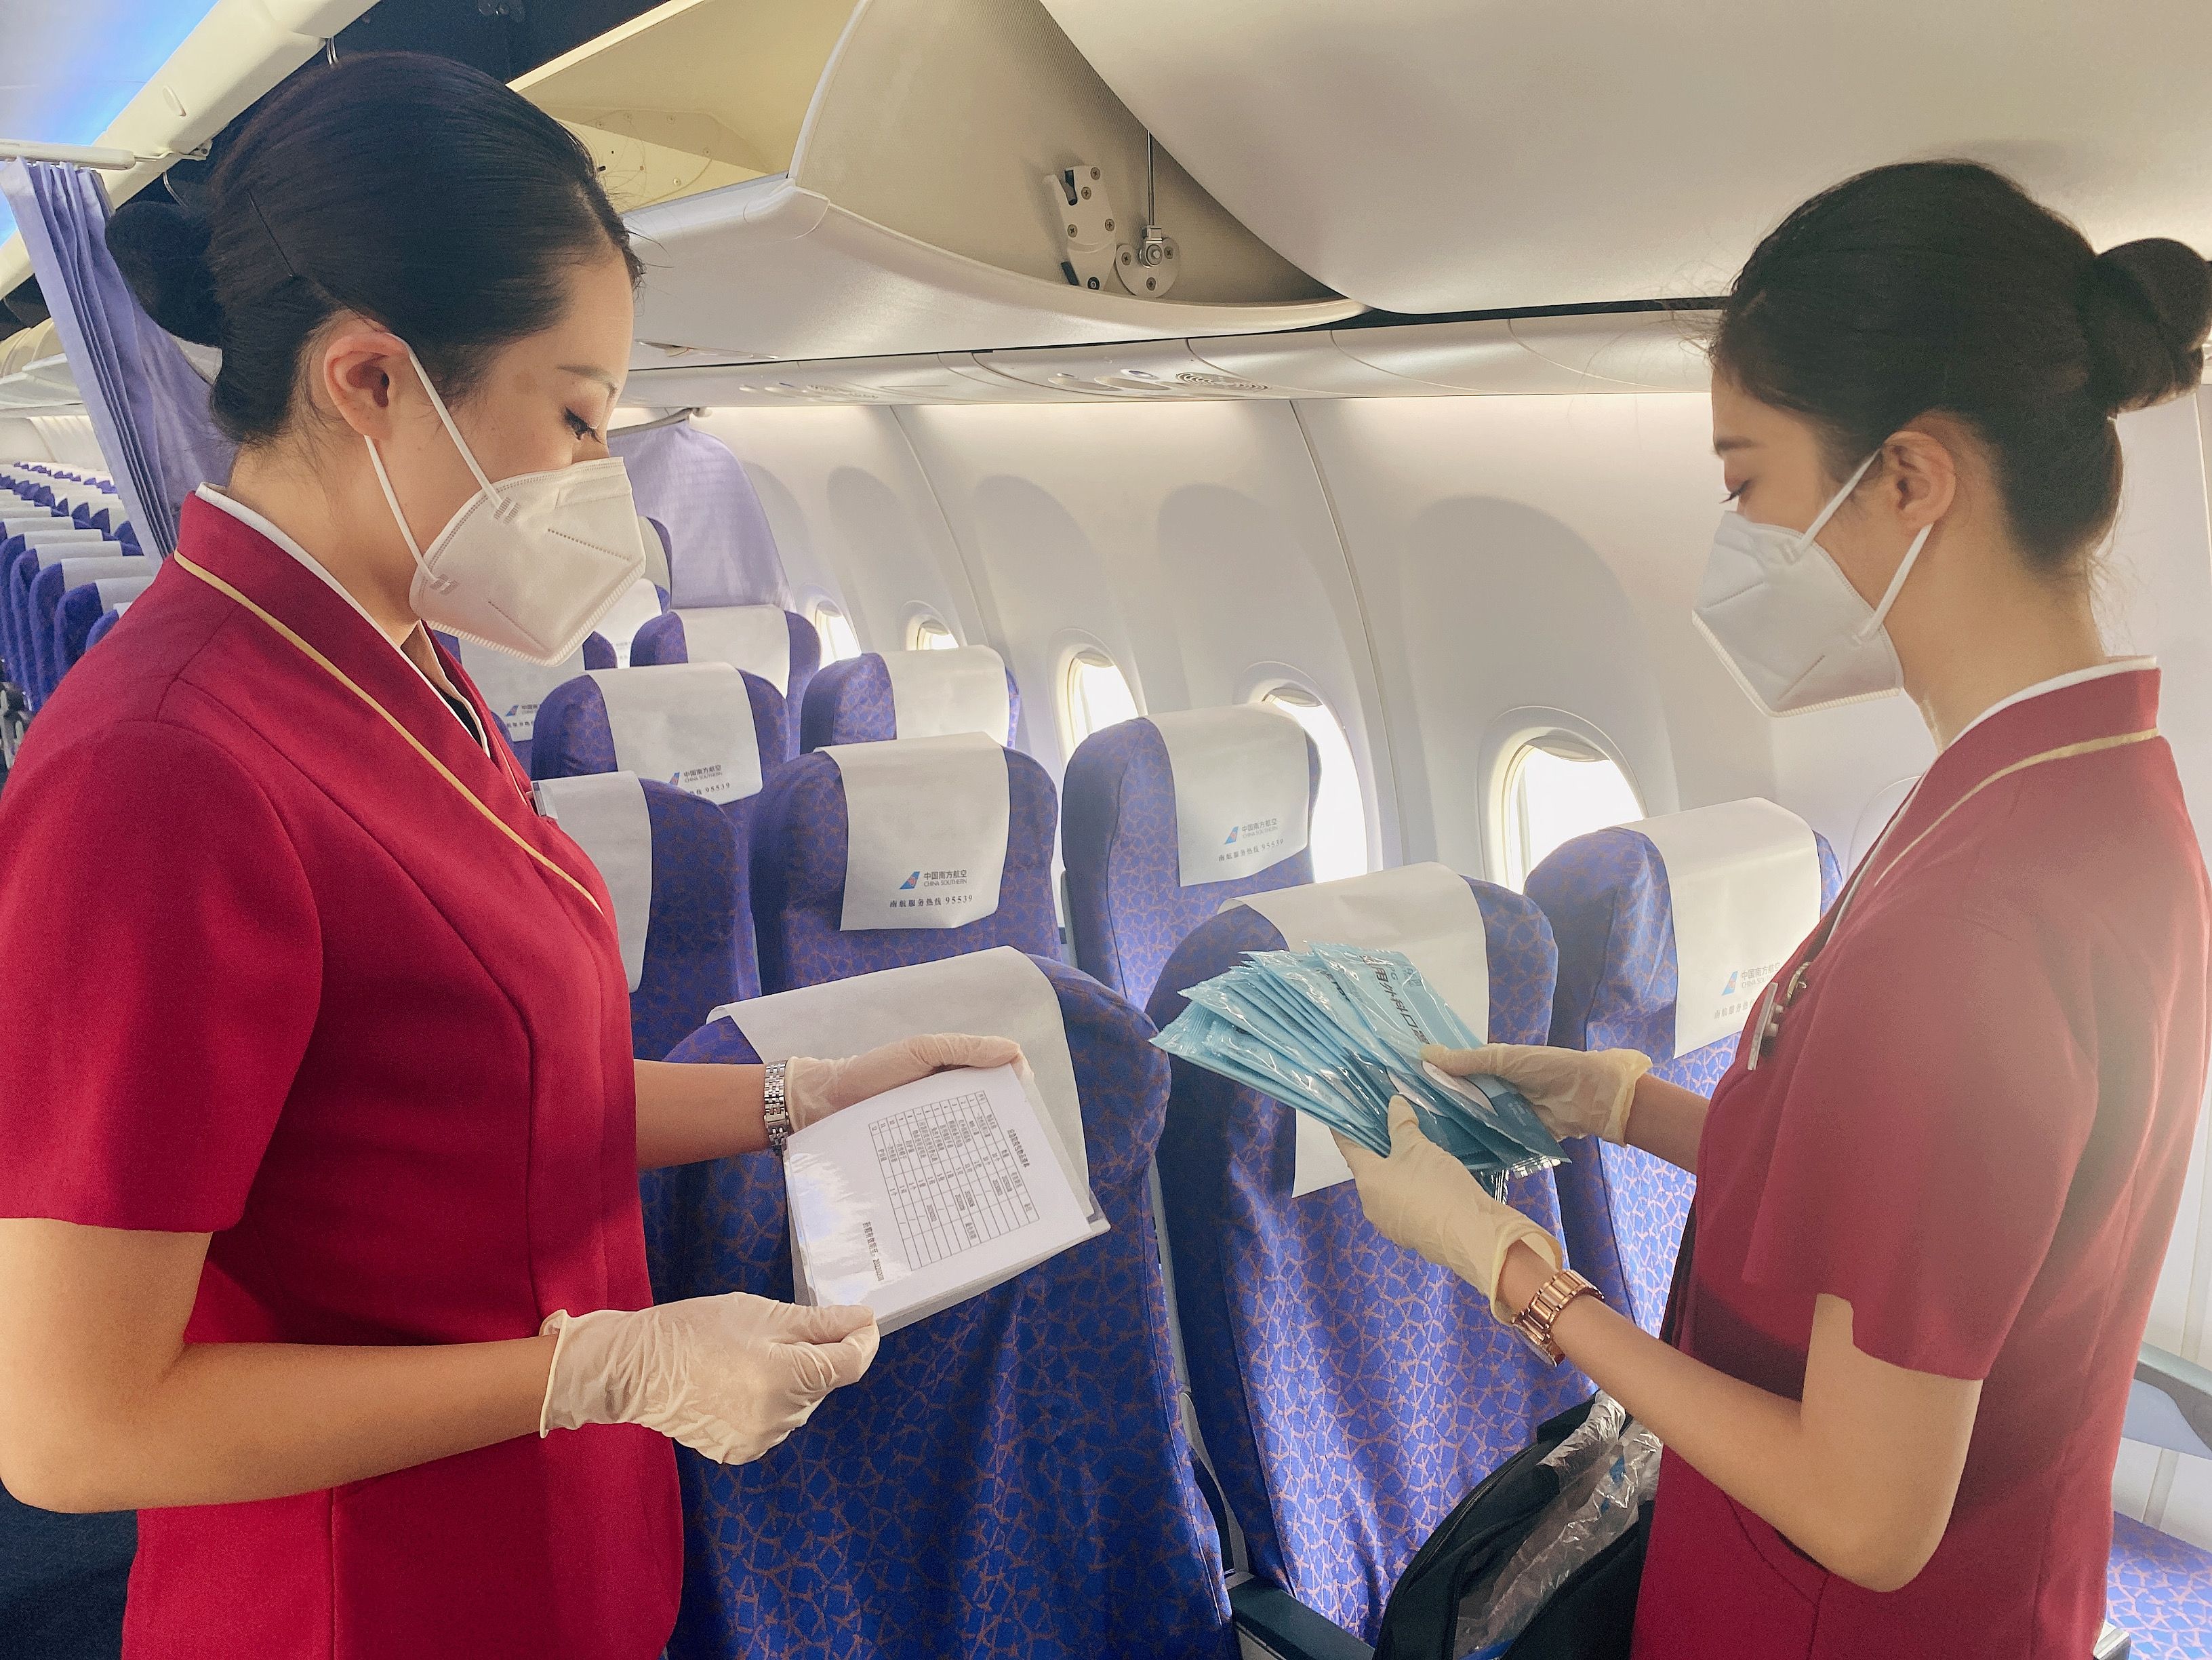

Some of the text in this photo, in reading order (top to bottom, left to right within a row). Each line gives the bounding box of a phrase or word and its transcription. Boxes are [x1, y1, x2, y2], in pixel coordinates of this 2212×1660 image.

[705, 782, 730, 793] 95539
[1241, 818, 1278, 833] 中国南方航空
[1262, 838, 1284, 850] 95539
[923, 869, 967, 881] 中国南方航空
[889, 894, 973, 908] 南航服务热线 95539
